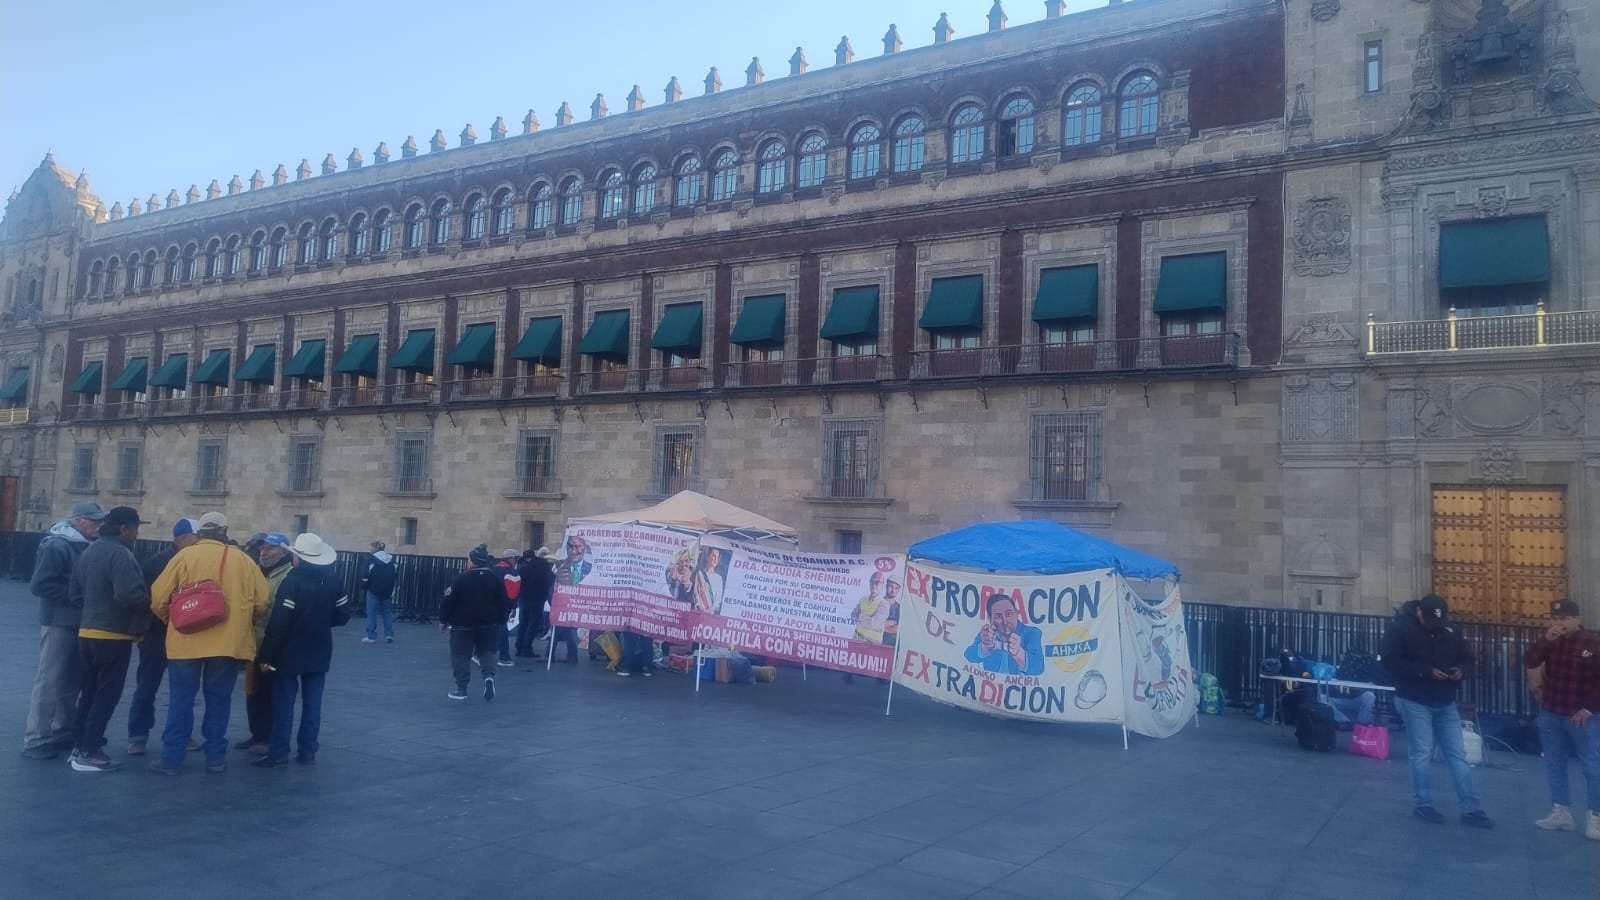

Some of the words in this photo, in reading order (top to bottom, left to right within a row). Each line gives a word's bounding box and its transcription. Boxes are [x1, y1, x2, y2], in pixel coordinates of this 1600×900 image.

[733, 560, 760, 572] DRA.
[761, 564, 801, 578] CLAUDIA
[803, 570, 862, 587] SHEINBAUM
[877, 559, 894, 571] 5%
[742, 582, 757, 590] CON
[769, 585, 810, 599] JUSTICIA
[813, 593, 845, 605] SOCIAL
[744, 573, 774, 583] GRACIAS
[800, 582, 847, 595] COMPROMISO
[906, 565, 1101, 624] EXPROPACION
[724, 597, 772, 611] RESPALDAMOS
[780, 607, 811, 618] NUESTRA
[759, 594, 791, 605] OBREROS
[803, 602, 837, 614] COAHUILA
[726, 618, 751, 632] DRA.
[751, 623, 790, 639] CLAUDIA
[792, 630, 849, 649] SHEINBAUM
[741, 610, 774, 623] UNIDAD
[776, 616, 783, 625] Y
[783, 618, 814, 631] APOYO
[815, 624, 822, 632] A
[824, 625, 836, 634] LA
[925, 611, 956, 645] DE
[765, 636, 794, 656] CON
[797, 643, 888, 673] SHEINBAUM!!
[1051, 641, 1092, 658] AHMSA
[902, 649, 1066, 714] EXTRADICION
[1004, 674, 1041, 687] ANCIRA
